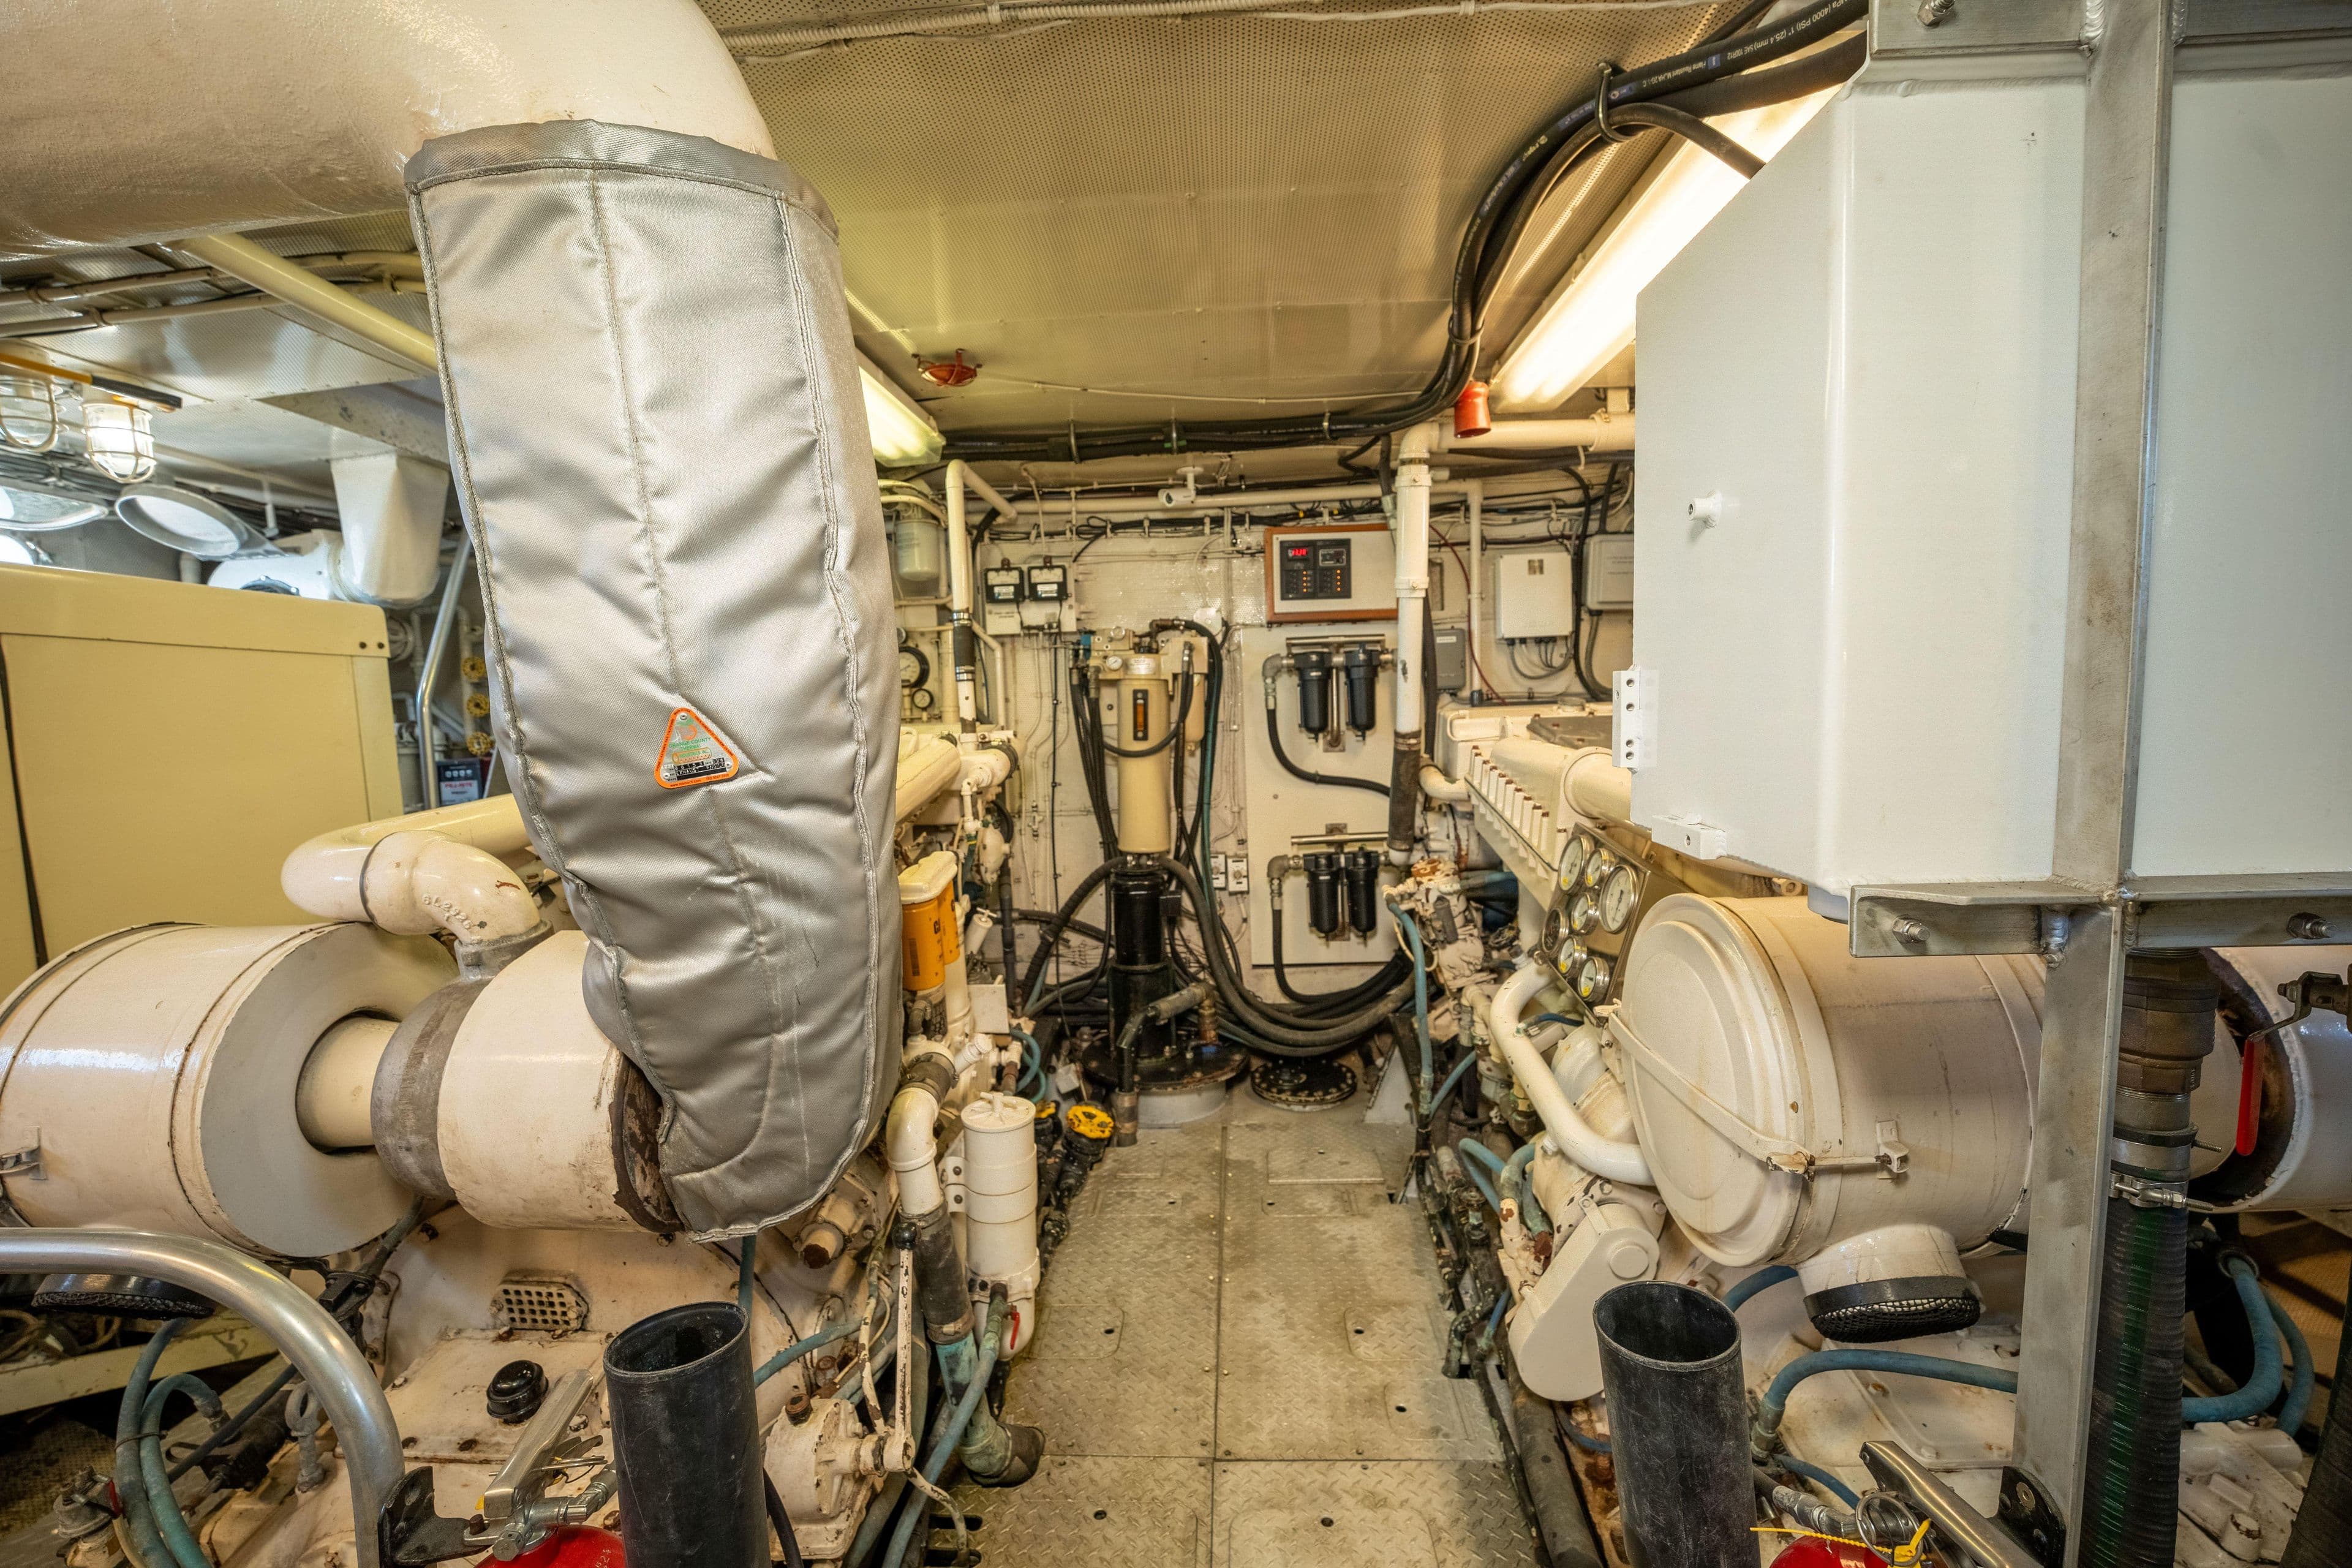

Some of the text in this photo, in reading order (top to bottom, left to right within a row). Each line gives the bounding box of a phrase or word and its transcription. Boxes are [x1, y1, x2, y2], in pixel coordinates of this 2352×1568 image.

[1812, 4, 1831, 23] (4000
[1796, 17, 1811, 31] PSI)
[1770, 29, 1787, 45] (25.4
[1754, 39, 1769, 51] mm)
